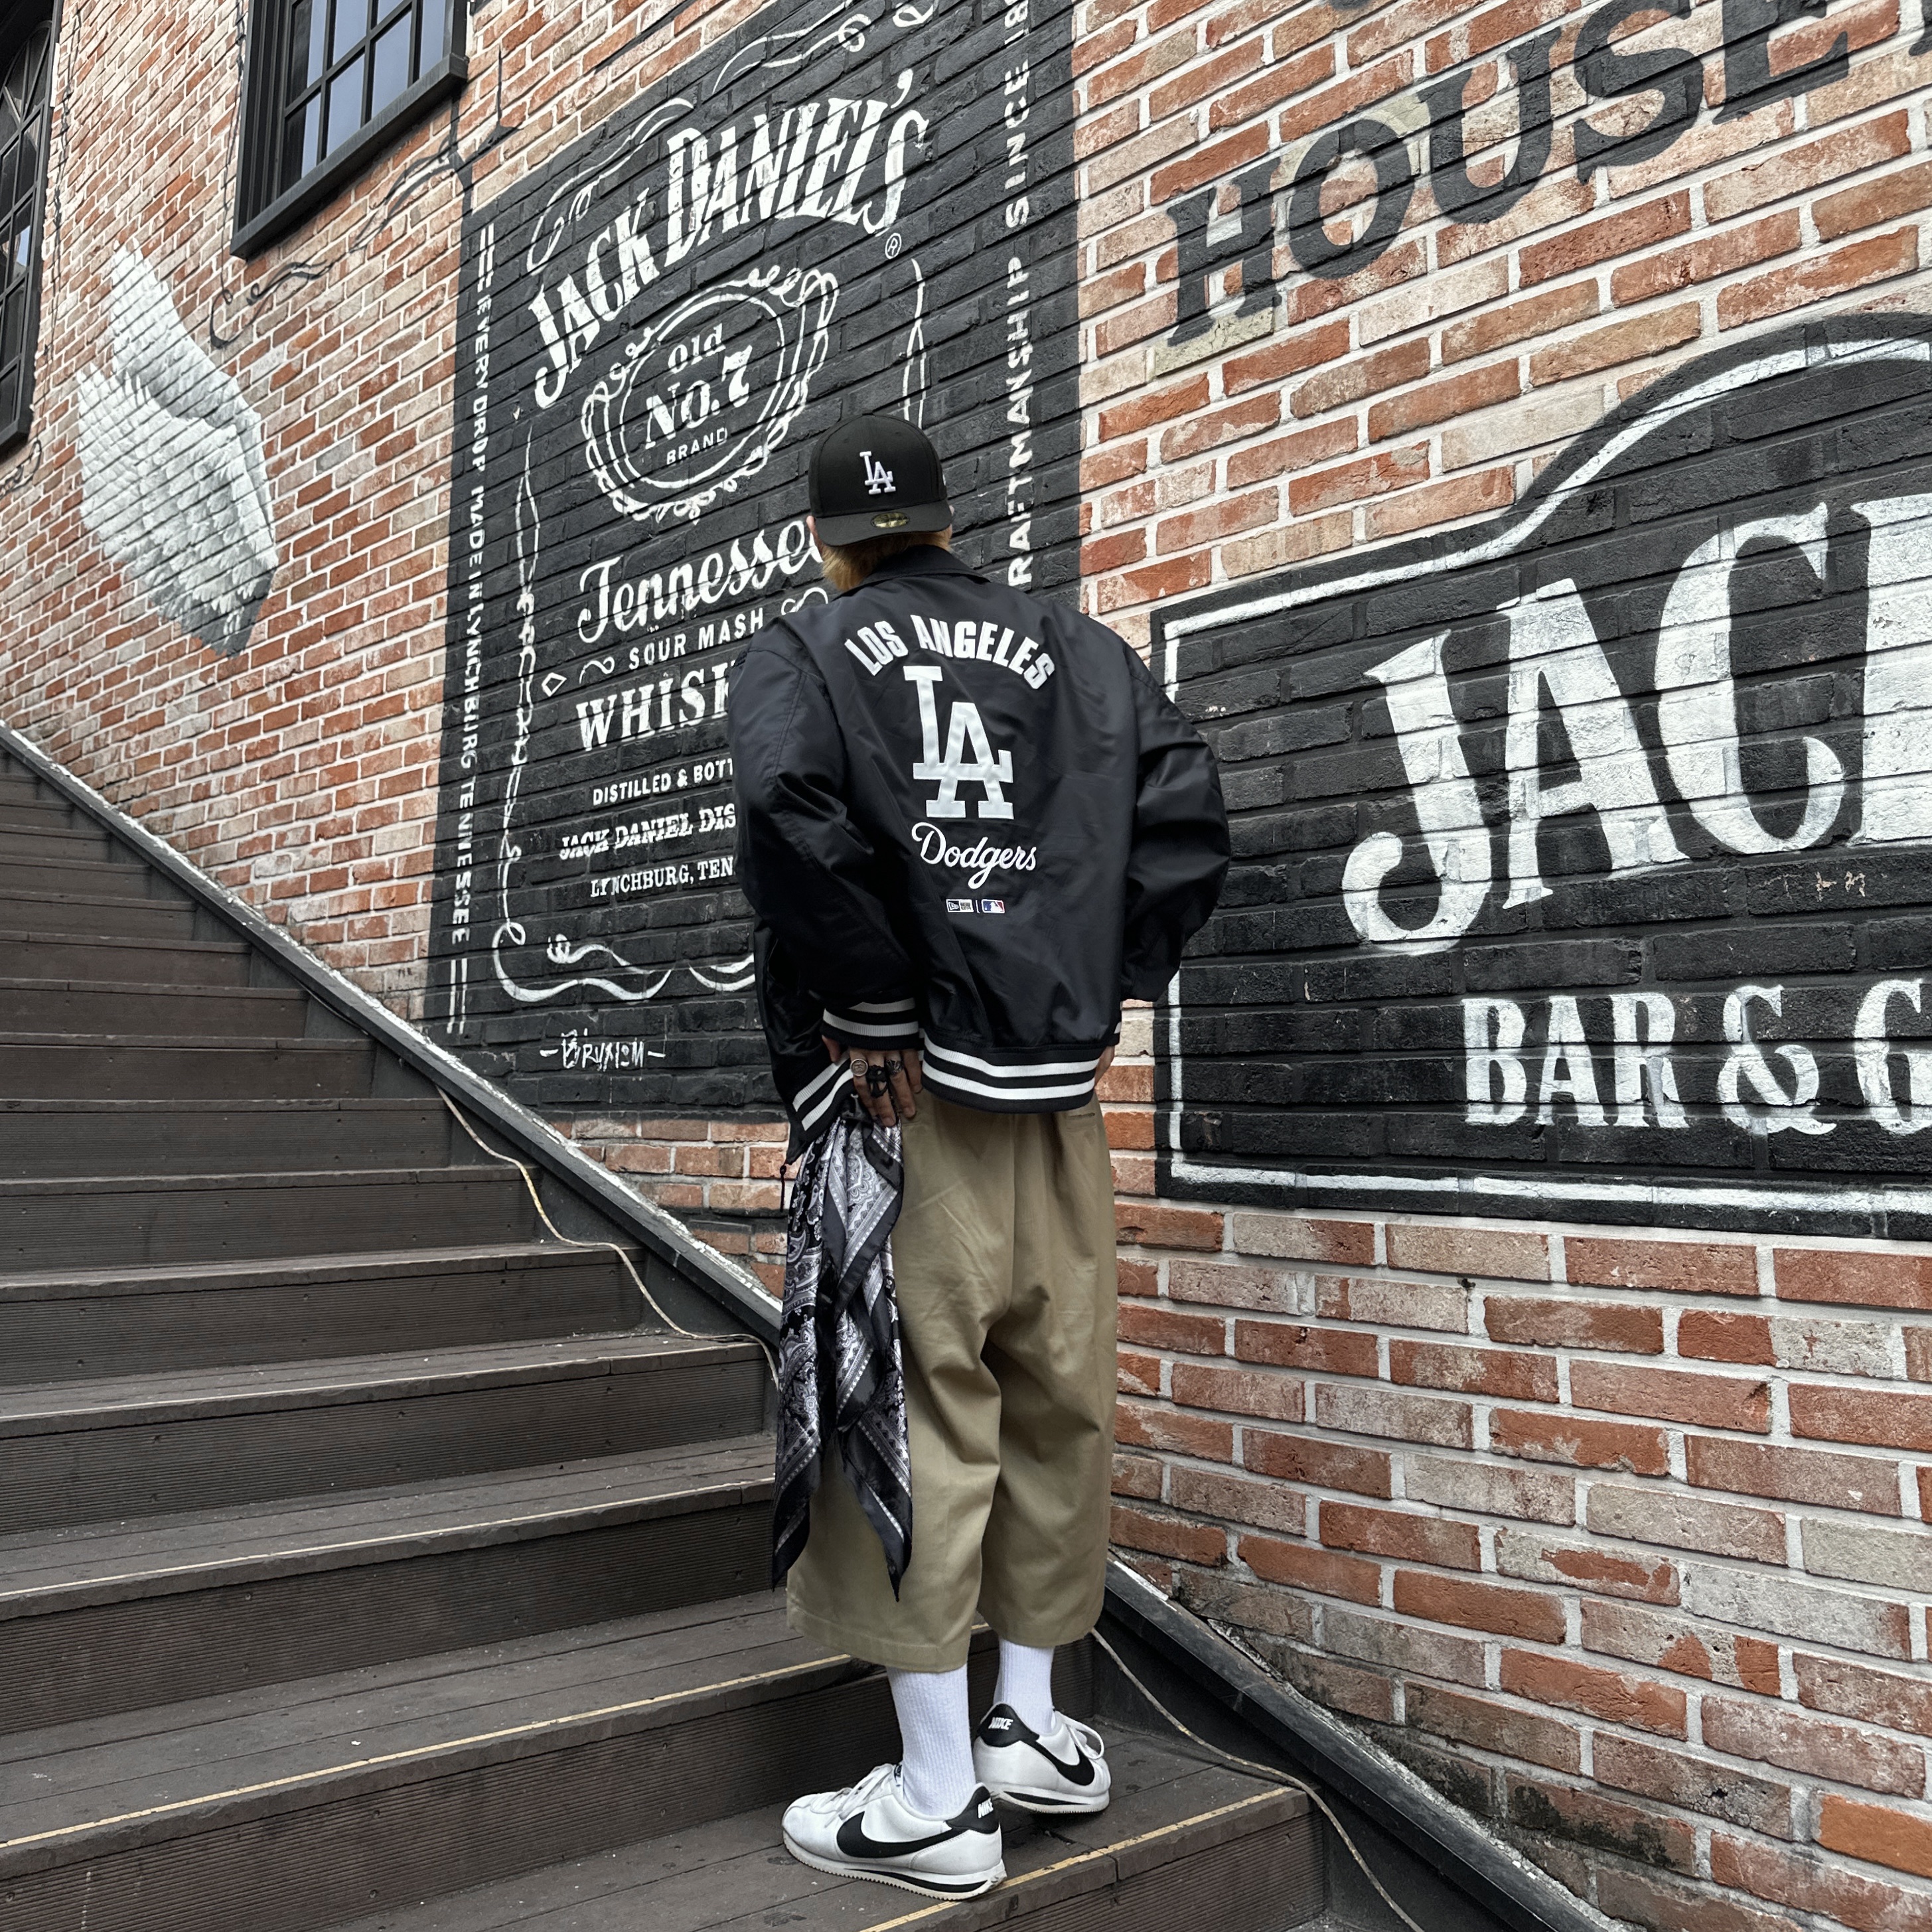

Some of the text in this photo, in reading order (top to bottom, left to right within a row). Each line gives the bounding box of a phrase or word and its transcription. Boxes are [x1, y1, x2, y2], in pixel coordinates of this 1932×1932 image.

[1004, 58, 1030, 229] SINCE
[1166, 0, 1849, 347] HOUSE
[529, 69, 930, 409] JACK DANIEL'S
[666, 427, 728, 465] BRAND
[859, 451, 897, 495] LA
[451, 295, 492, 945] EVERY DROP MADE IN LYNCHBURG TENNESSEE
[629, 607, 763, 670] SOUR MASH
[844, 614, 1056, 690] LOS ANGELES
[903, 664, 1014, 820] LA
[593, 773, 672, 806] DISTILLED
[676, 769, 688, 788] &
[559, 802, 737, 860] JACK DANIEL DIS
[911, 822, 1037, 889] Dodgers
[590, 863, 695, 898] LYNCHBURG,
[1460, 992, 1688, 1129] BAR
[1717, 985, 1836, 1135] &
[988, 1717, 1013, 1731] NIKE
[978, 1798, 994, 1819] NIKE
